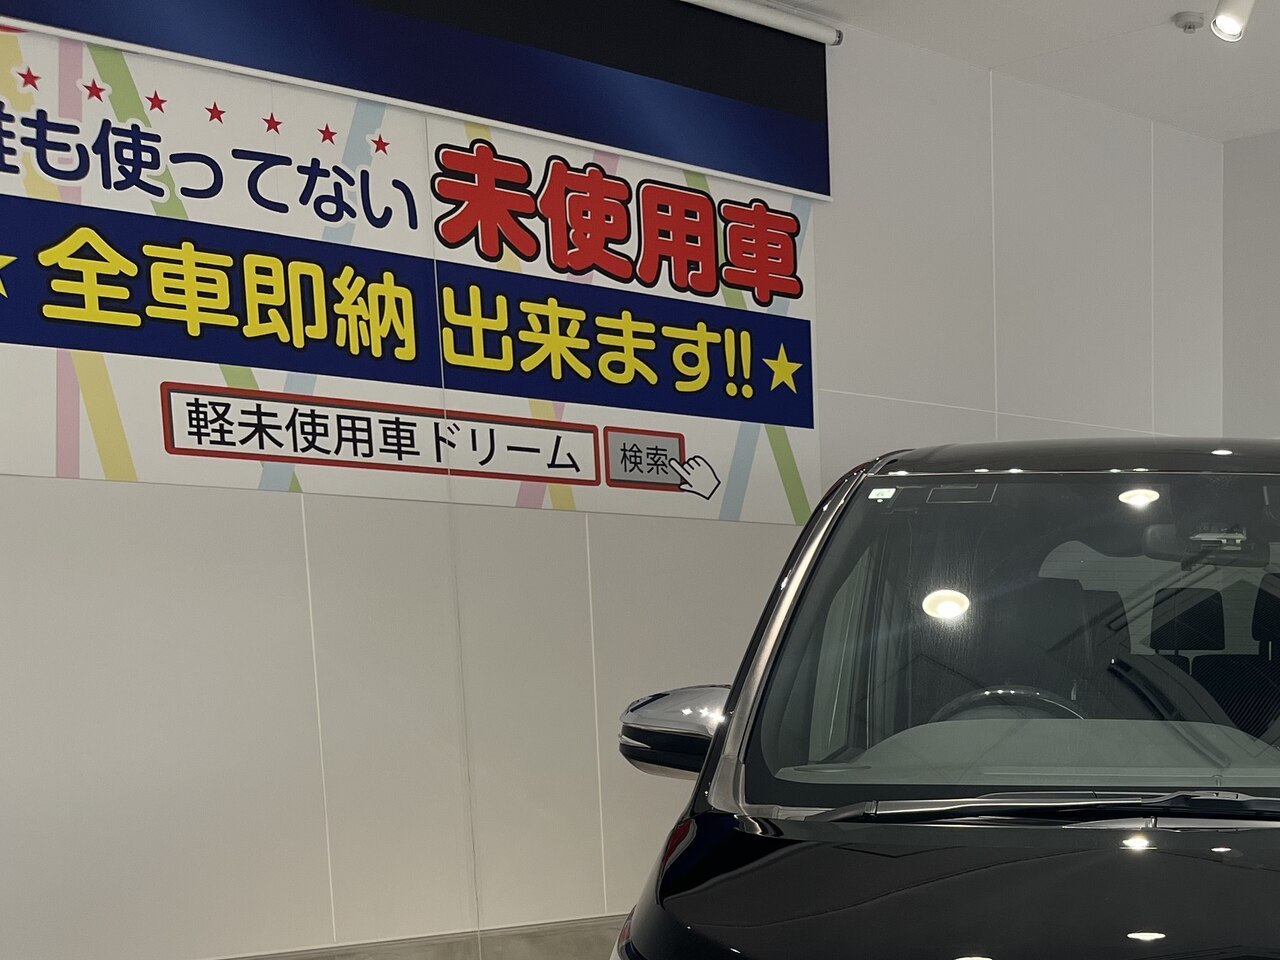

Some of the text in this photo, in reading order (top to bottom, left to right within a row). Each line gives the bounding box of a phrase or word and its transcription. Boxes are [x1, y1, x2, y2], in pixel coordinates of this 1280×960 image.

[431, 138, 803, 305] 未使用車
[37, 226, 416, 363] 全車即納
[185, 396, 581, 475] 軽未使用車ドリーム
[620, 442, 669, 475] 検索
